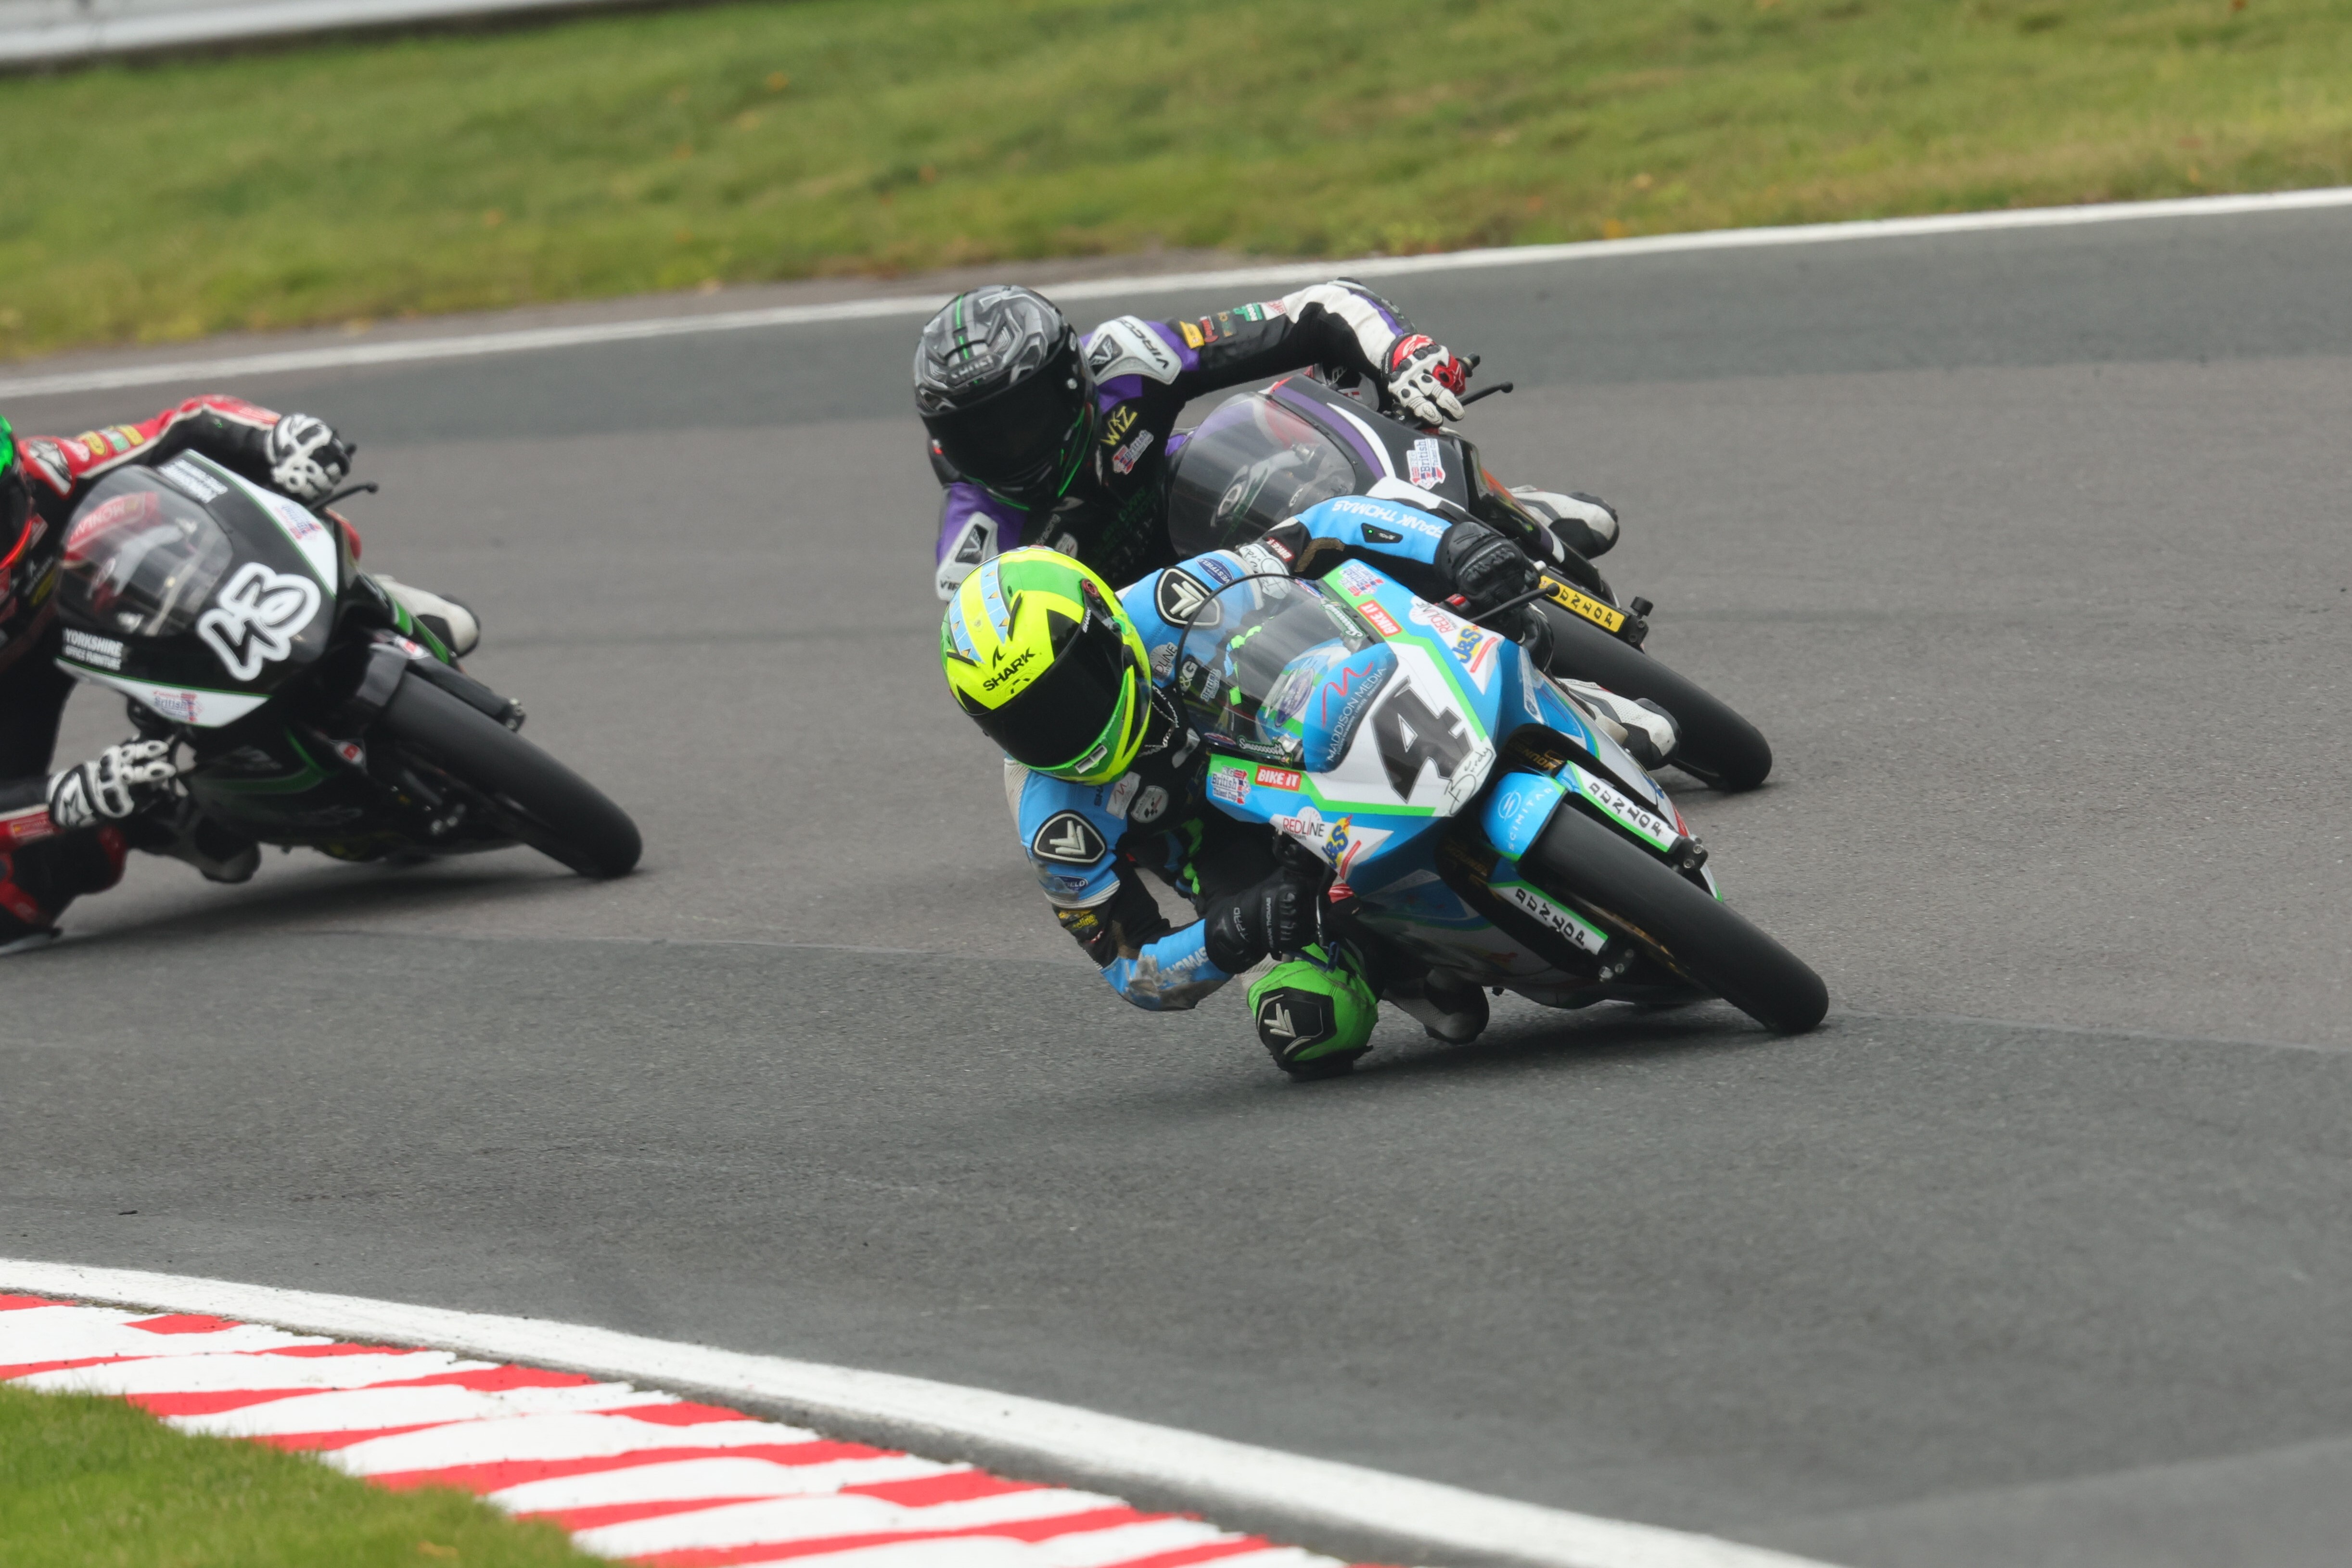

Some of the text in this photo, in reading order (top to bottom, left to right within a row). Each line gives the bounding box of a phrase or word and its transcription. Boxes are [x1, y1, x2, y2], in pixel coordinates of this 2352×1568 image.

[1417, 441, 1431, 473] British
[1333, 499, 1400, 526] THOMAS
[199, 562, 321, 681] 43
[1082, 608, 1092, 633] SHARK
[1360, 603, 1398, 634] BIKE IT
[1416, 602, 1454, 634] REDLINE
[1559, 588, 1613, 627] UNLOP
[63, 627, 123, 657] YORKSHIRE
[983, 648, 1036, 691] SHARK
[1326, 697, 1359, 762] MADDISON
[1355, 667, 1387, 698] MEDIA
[1370, 676, 1473, 804] 4
[1212, 772, 1237, 790] British
[1257, 769, 1299, 787] BIKE IT
[1508, 786, 1554, 852] SCIMITAR
[1589, 783, 1662, 836] DUNLOP
[1283, 817, 1325, 837] REDLINE
[1515, 887, 1585, 947] DUNLOP
